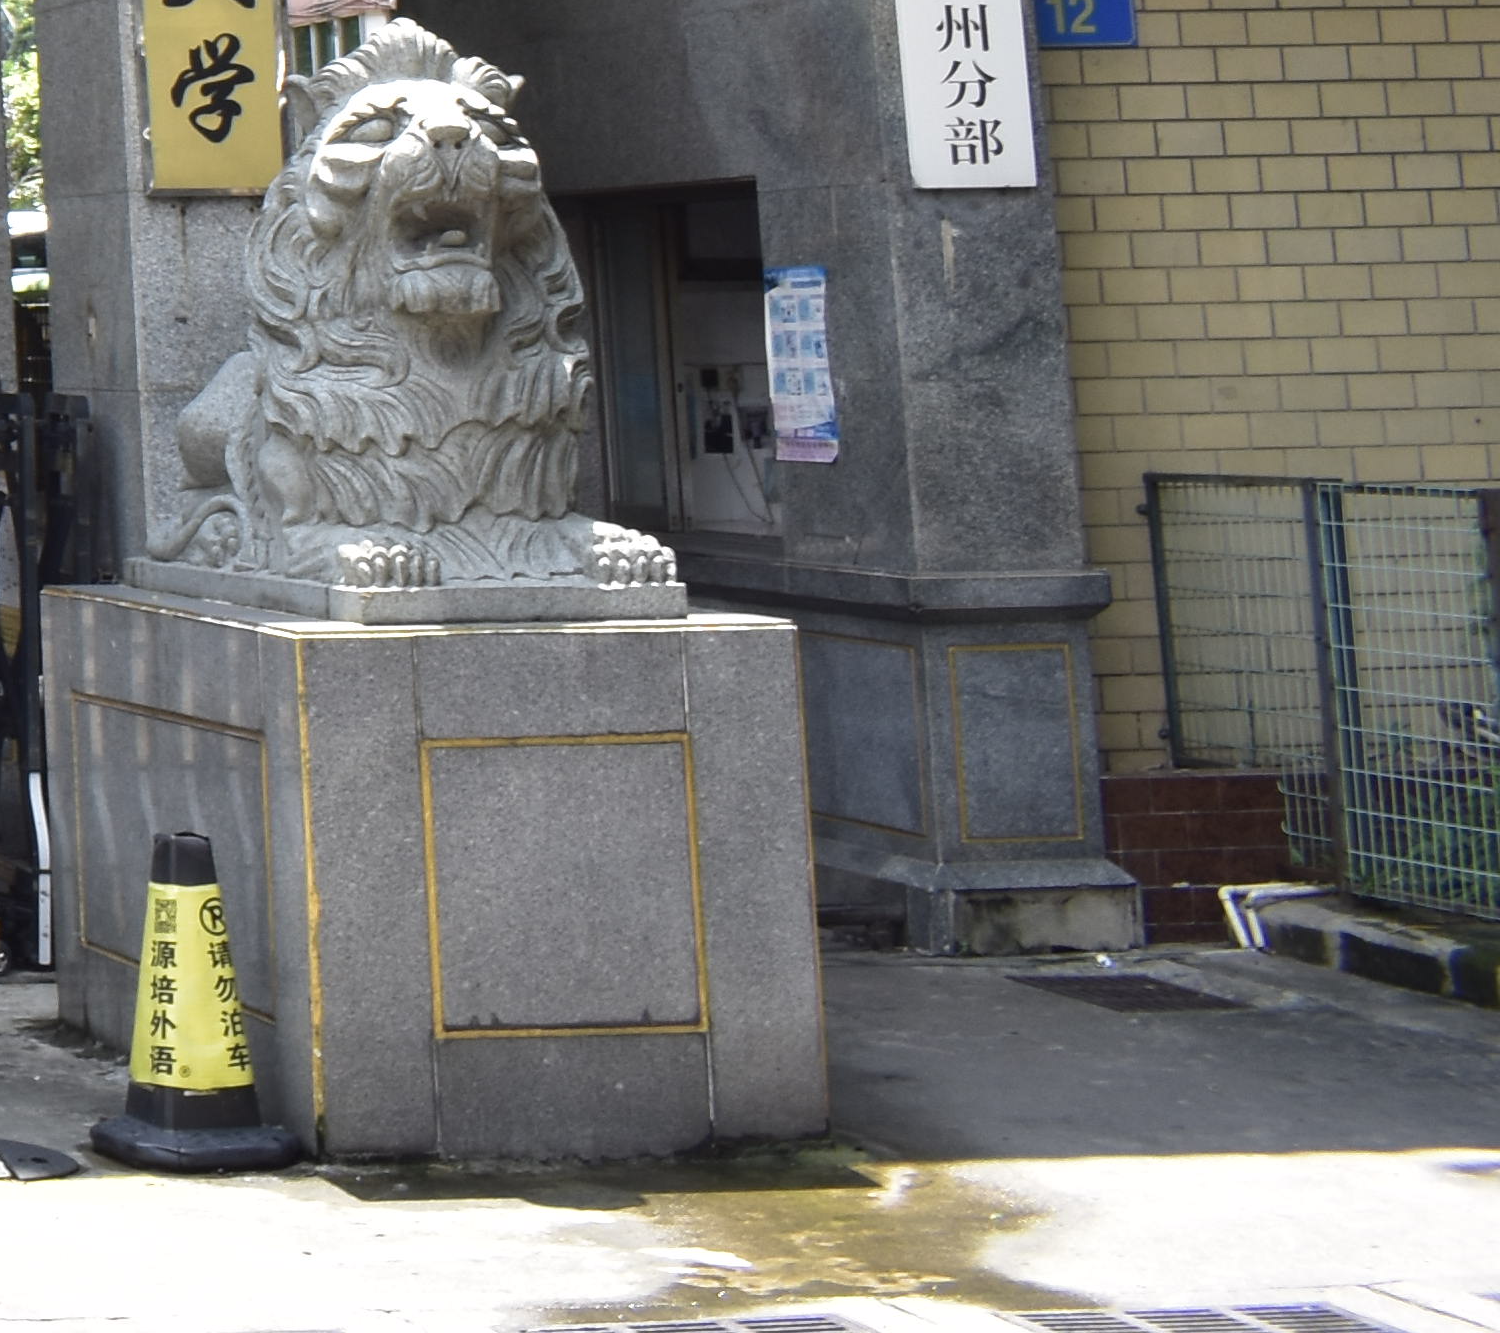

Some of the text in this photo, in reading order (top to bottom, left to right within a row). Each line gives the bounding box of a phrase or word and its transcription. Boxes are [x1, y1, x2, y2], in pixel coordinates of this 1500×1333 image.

[150, 940, 178, 1076] 源培外语
[207, 939, 251, 1072] 请勿泊车
